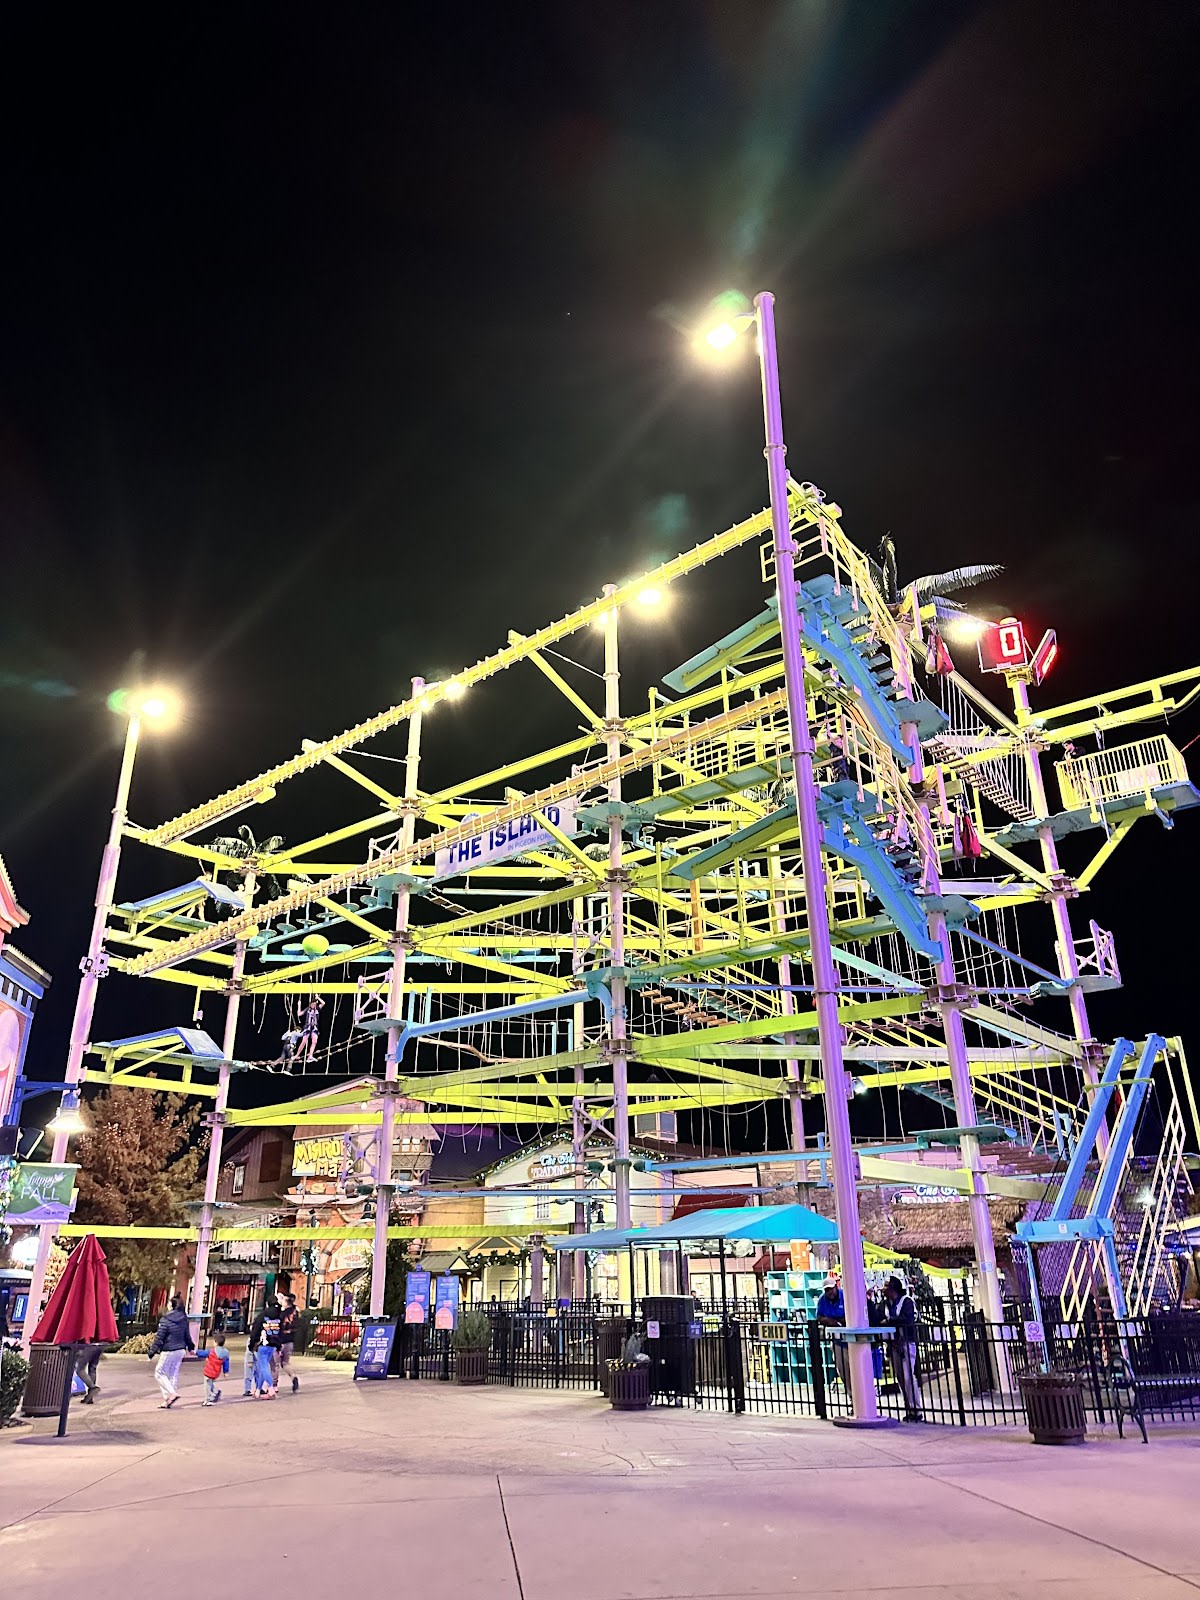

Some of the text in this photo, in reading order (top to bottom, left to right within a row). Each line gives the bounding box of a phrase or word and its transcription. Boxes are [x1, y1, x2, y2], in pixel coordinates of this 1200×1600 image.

[999, 626, 1021, 657] 0
[449, 836, 482, 863] THE
[514, 837, 536, 850] PIGEON
[20, 1186, 60, 1200] FALL
[762, 1325, 784, 1339] EXIT
